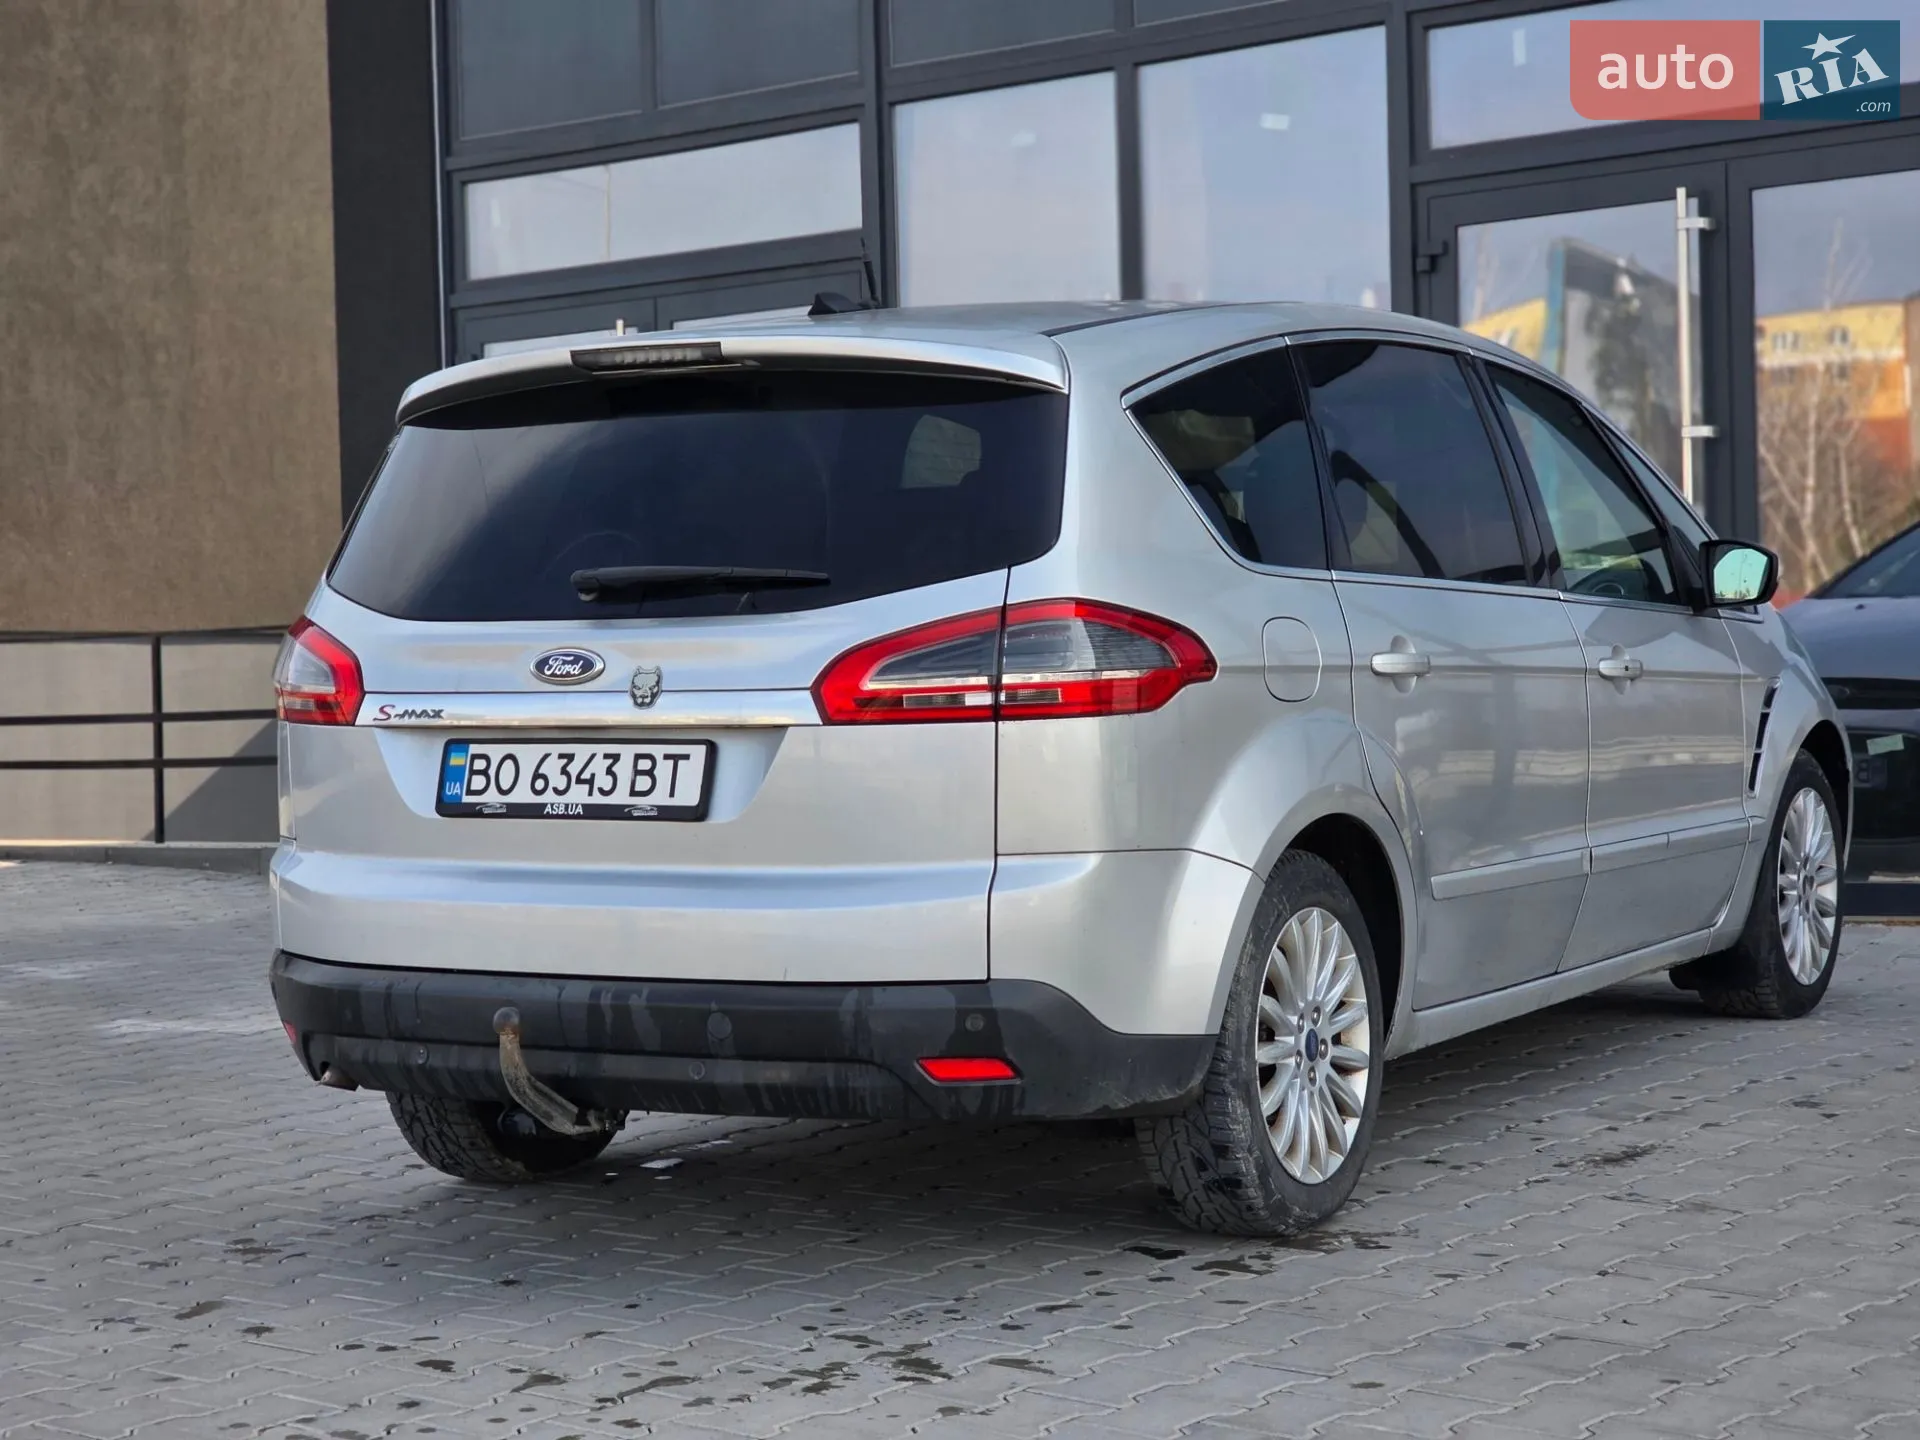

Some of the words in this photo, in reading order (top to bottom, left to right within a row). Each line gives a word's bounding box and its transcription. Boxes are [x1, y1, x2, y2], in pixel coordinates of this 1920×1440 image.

[544, 656, 583, 675] Ford
[373, 704, 444, 721] S-MAX
[465, 753, 520, 797] BO
[530, 753, 621, 797] 6343
[629, 753, 691, 798] BT
[445, 787, 461, 796] UA
[544, 803, 584, 815] ASB.UA
